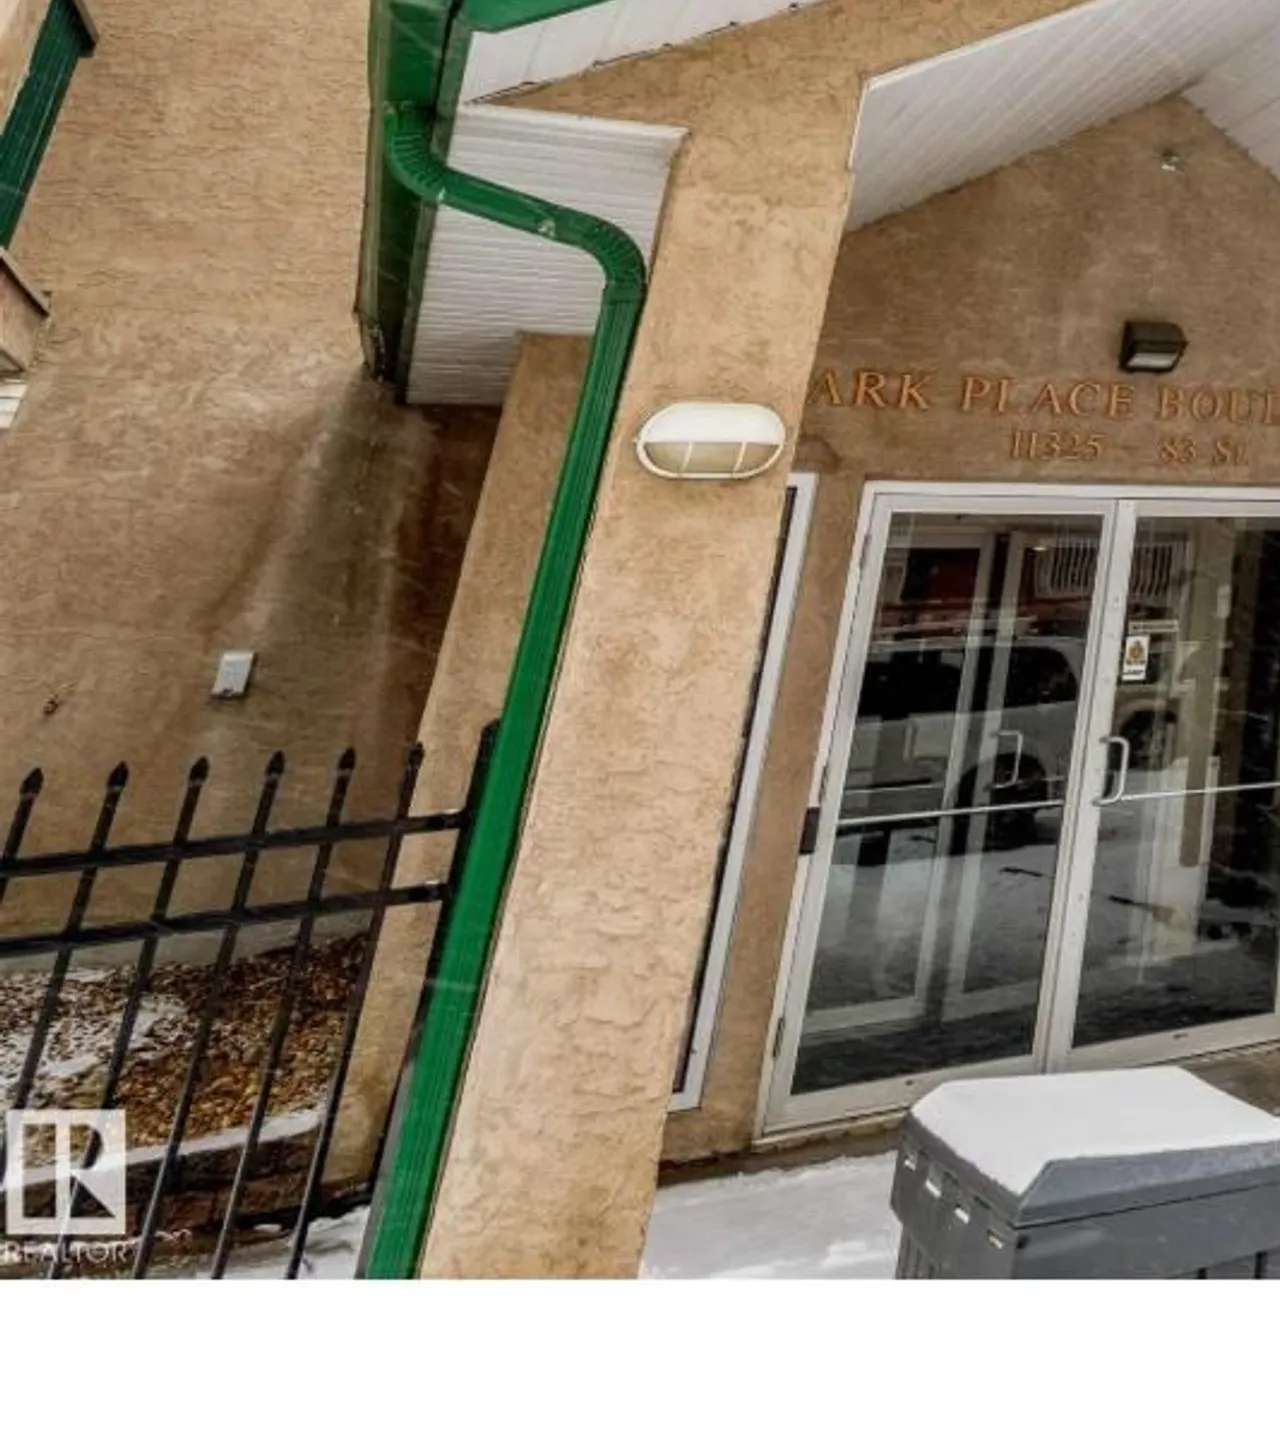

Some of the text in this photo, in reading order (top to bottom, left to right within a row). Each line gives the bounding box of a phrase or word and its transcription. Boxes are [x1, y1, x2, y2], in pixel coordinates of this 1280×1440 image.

[806, 366, 932, 410] ARK
[961, 376, 1134, 418] PLACE
[1010, 427, 1104, 461] 11325
[1158, 436, 1198, 464] 83
